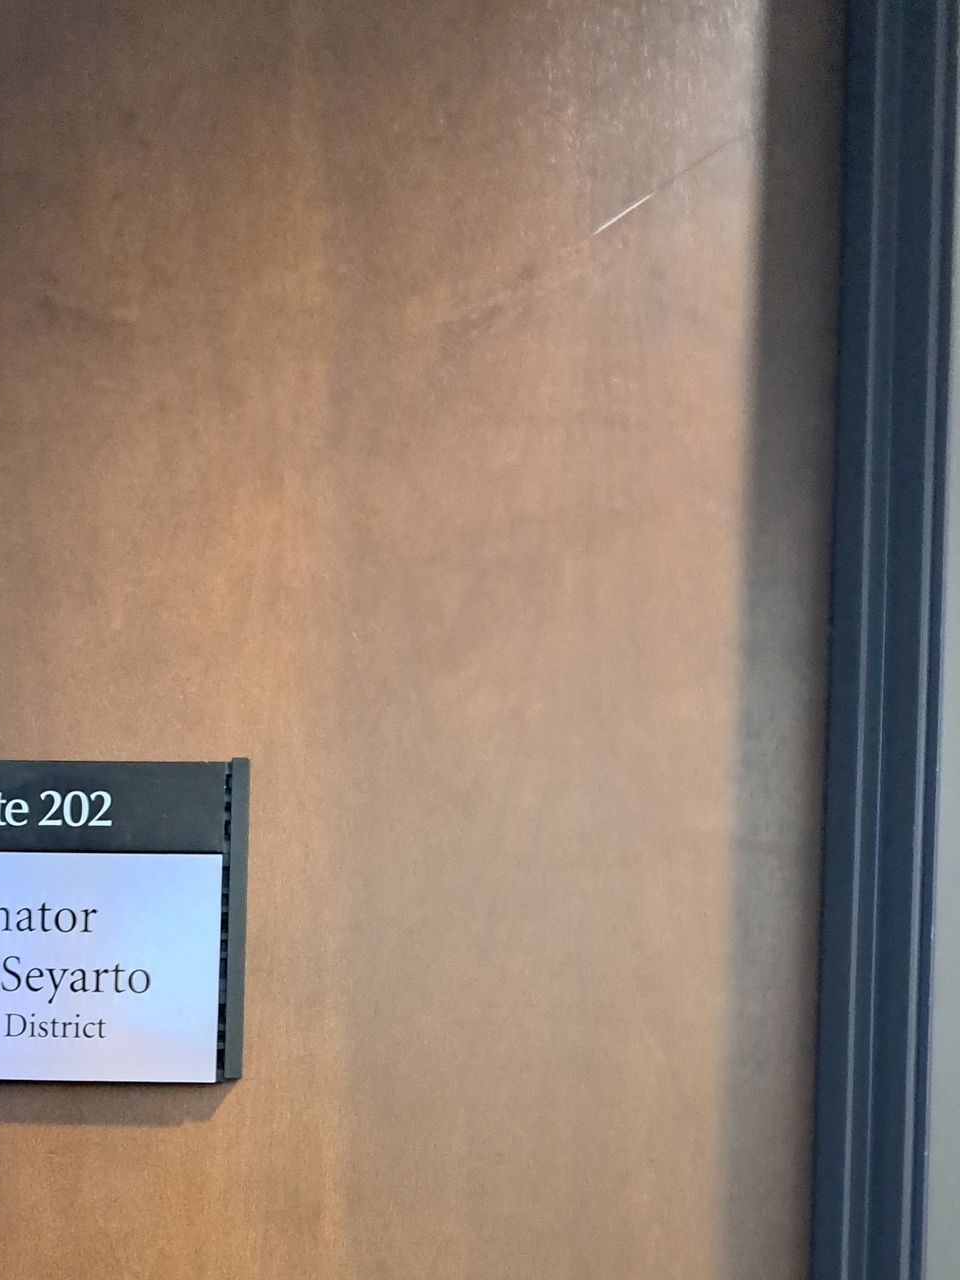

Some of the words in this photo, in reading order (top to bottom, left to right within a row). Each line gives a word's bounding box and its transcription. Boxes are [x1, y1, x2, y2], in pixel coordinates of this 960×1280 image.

[38, 790, 112, 827] 202
[1, 956, 152, 1004] Seyarto
[4, 1013, 106, 1039] District
